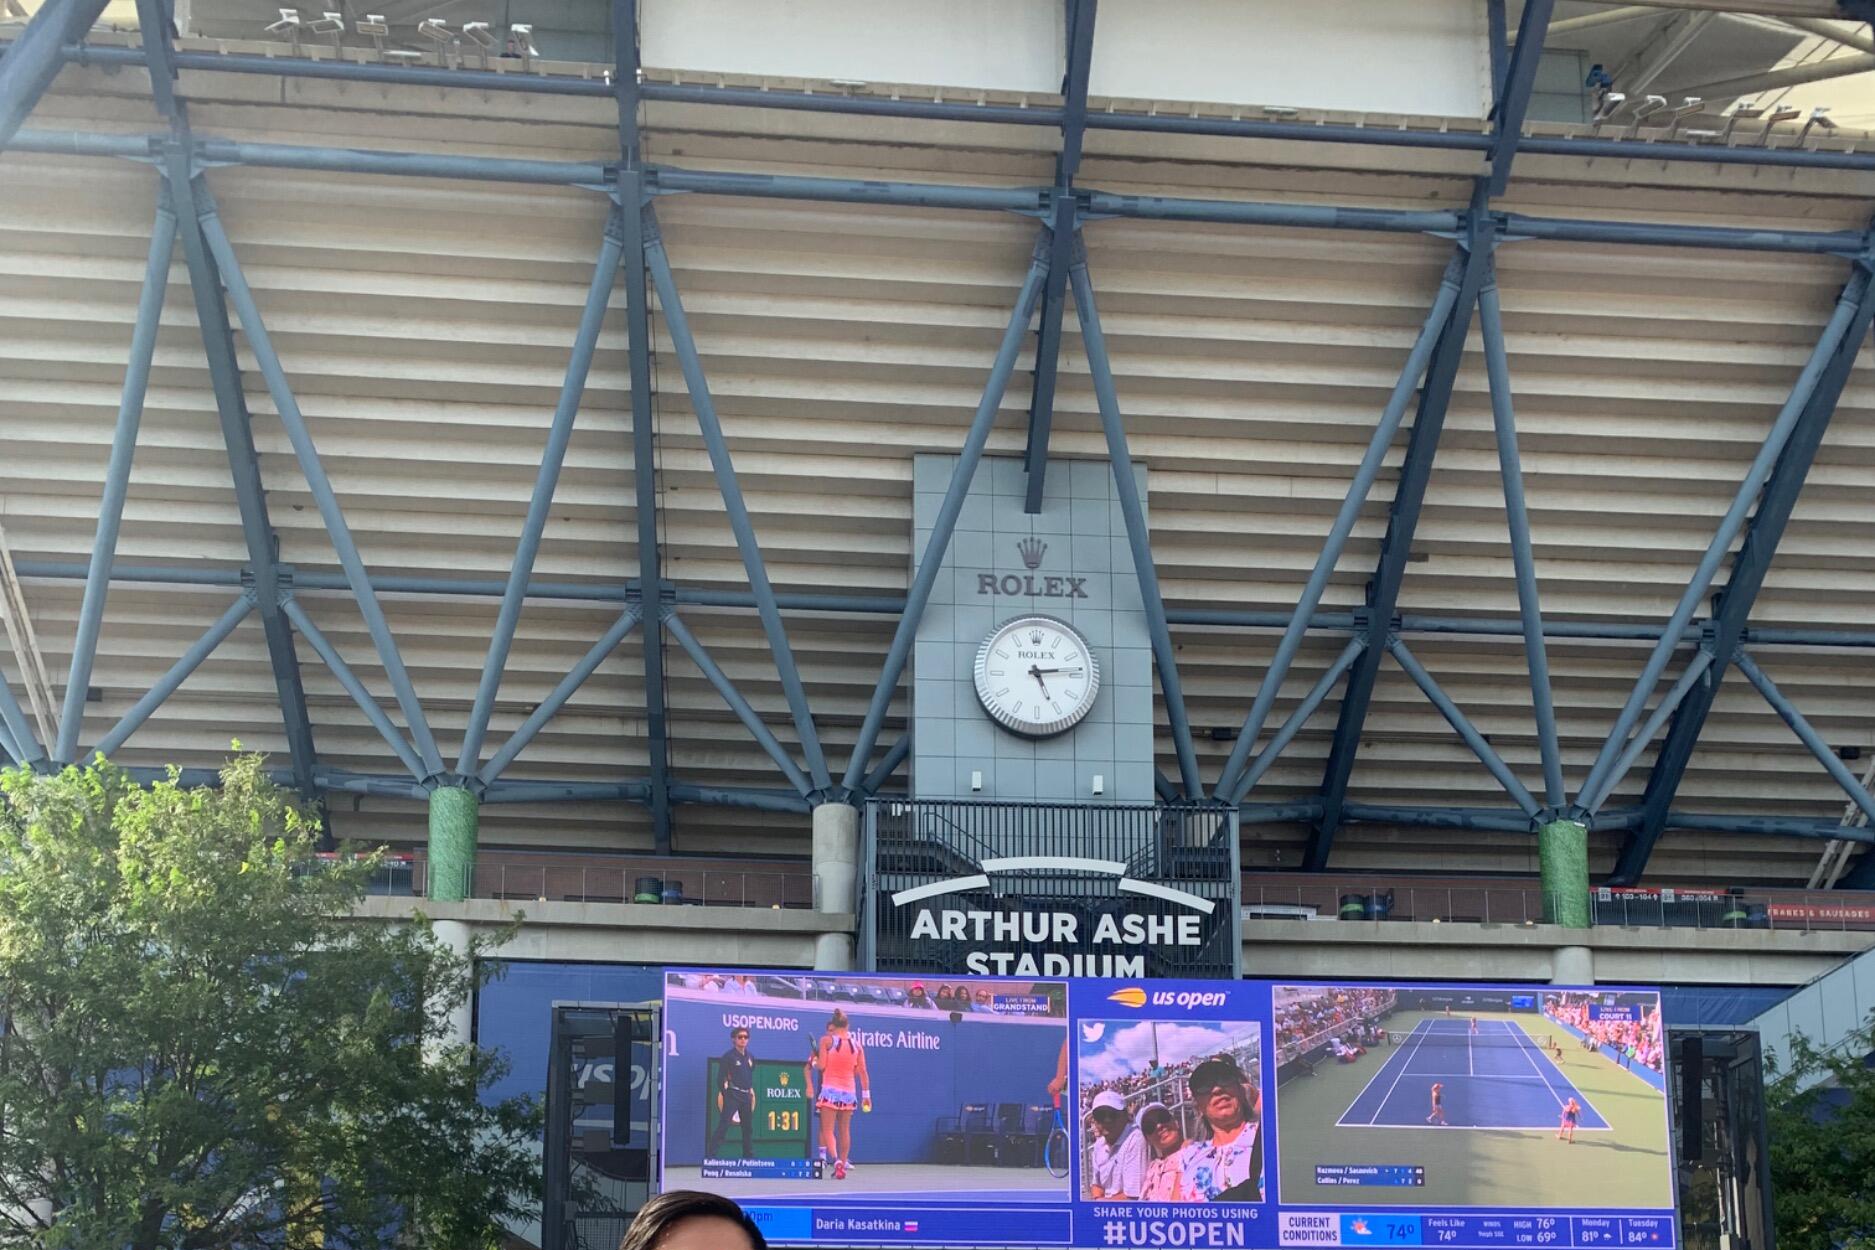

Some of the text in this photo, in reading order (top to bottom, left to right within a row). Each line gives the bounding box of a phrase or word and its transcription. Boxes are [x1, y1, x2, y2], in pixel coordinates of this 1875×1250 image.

[977, 574, 1088, 598] ROLEX
[1018, 651, 1055, 660] ROLEX
[1767, 908, 1805, 917] FRANKS
[910, 909, 1200, 945] ARTHUR ASHE
[966, 952, 1144, 978] STADIUM
[1152, 991, 1226, 1010] us open
[993, 1004, 1048, 1012] GRANDSTAND
[722, 1014, 799, 1031] USOPEN.ORG
[896, 1031, 940, 1050] Airline
[766, 1087, 801, 1099] ROLEX
[768, 1111, 799, 1130] 1:31
[1094, 1207, 1258, 1219] SHARE YOUR PHOTOS USING
[816, 1218, 901, 1231] Daria Kasatkina
[1288, 1217, 1330, 1228] CURRENT
[1428, 1219, 1465, 1227] Feels Like
[1514, 1221, 1532, 1229] HIGH
[1582, 1219, 1610, 1228] Monday
[1628, 1219, 1658, 1228] Tuesday
[1103, 1221, 1245, 1246] #USOPEN
[1282, 1230, 1338, 1241] CONDITIONS
[1516, 1234, 1532, 1242] LOW
